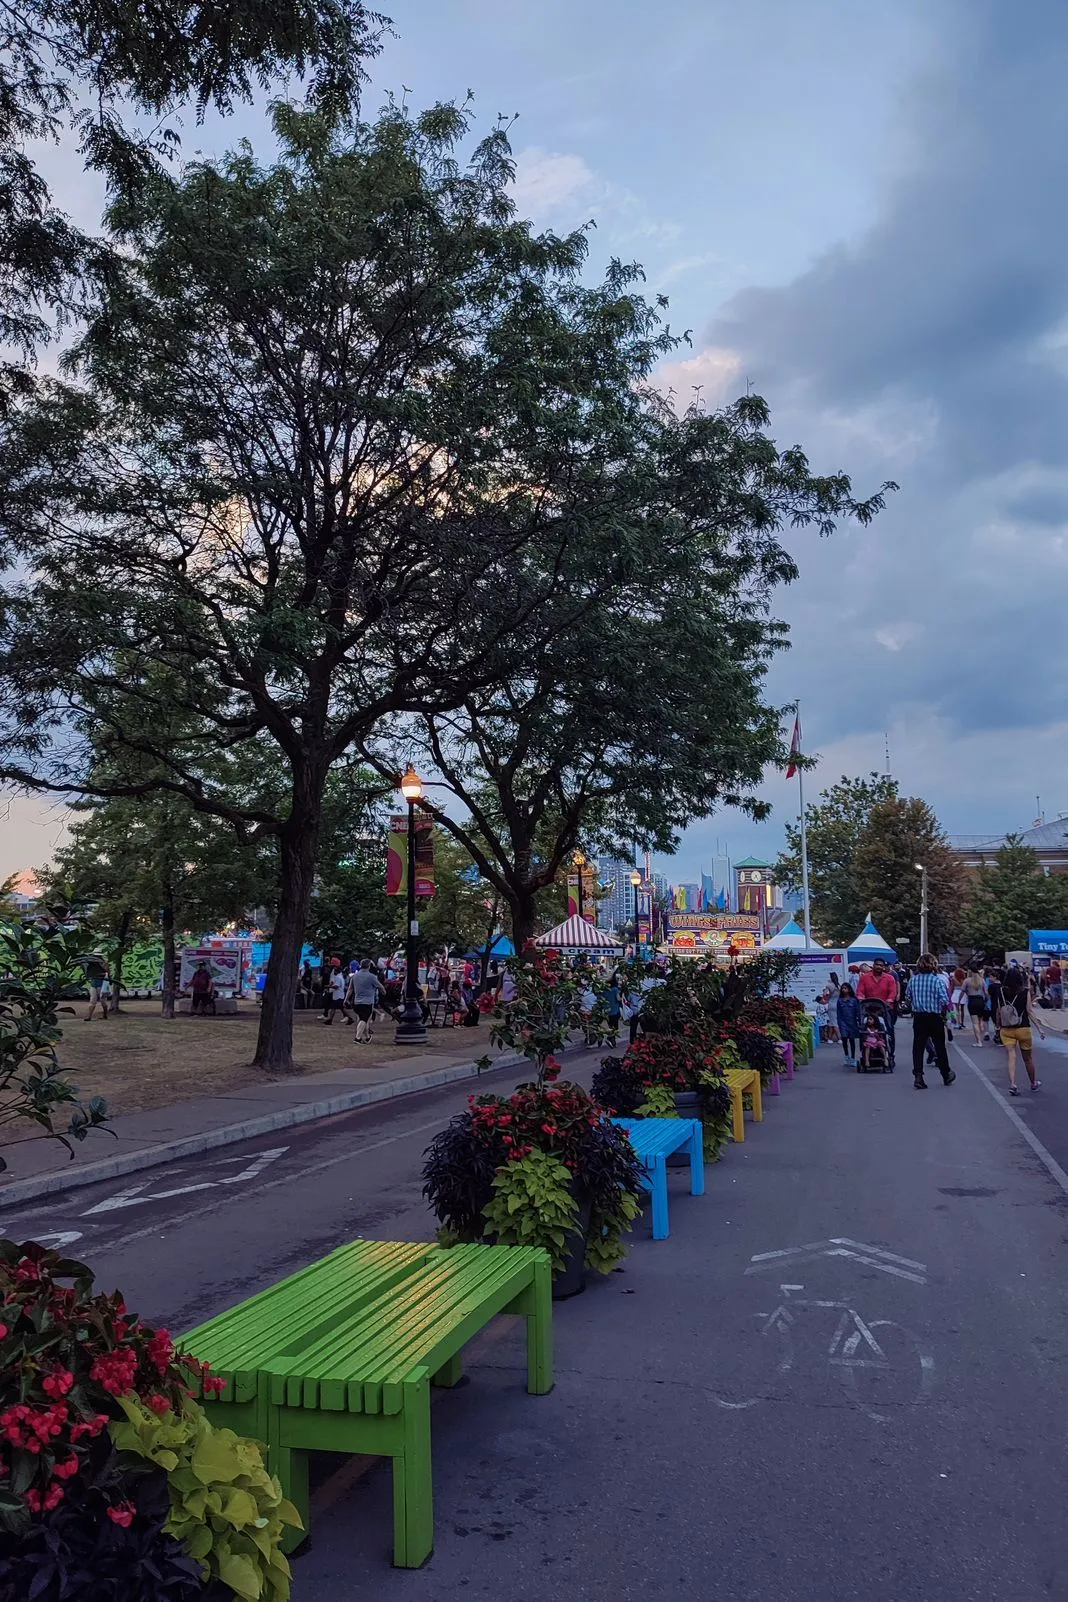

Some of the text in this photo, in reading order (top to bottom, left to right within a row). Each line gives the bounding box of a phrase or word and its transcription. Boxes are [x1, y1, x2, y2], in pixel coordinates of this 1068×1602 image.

[391, 821, 408, 829] CNE
[671, 916, 710, 928] WINGS
[717, 915, 759, 929] FRIES
[1038, 942, 1058, 952] Tiny
